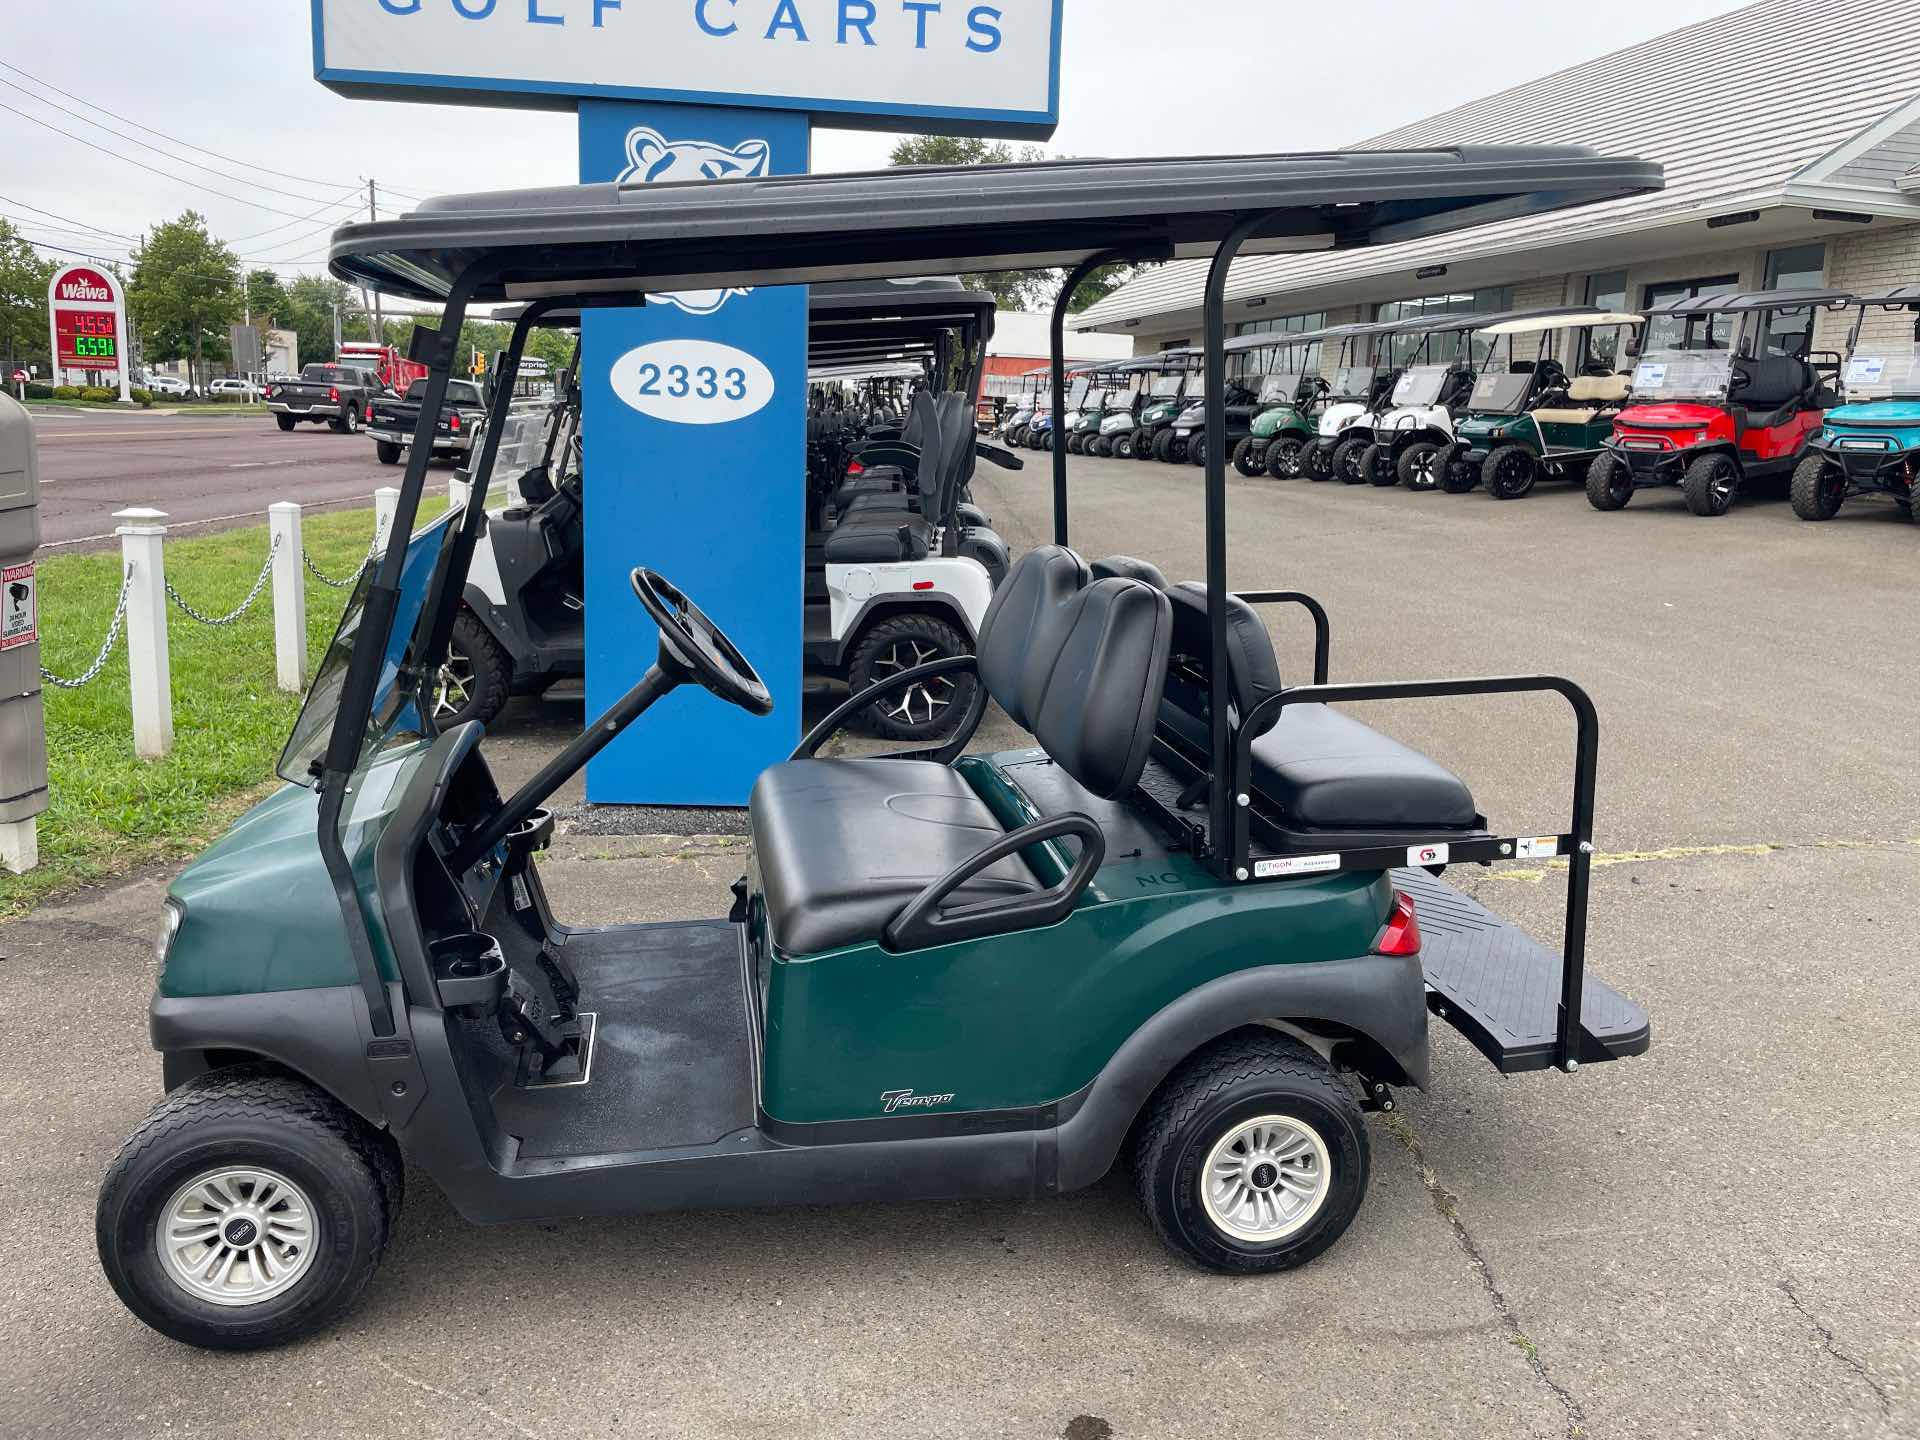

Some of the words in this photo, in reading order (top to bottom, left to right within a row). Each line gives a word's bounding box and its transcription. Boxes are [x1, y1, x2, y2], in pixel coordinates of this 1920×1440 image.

[694, 0, 1003, 53] CARTS
[61, 283, 108, 300] Wawa
[520, 361, 548, 369] erprise
[638, 363, 747, 401] 2333
[4, 565, 34, 581] WARNING
[880, 1088, 956, 1113] Tempo
